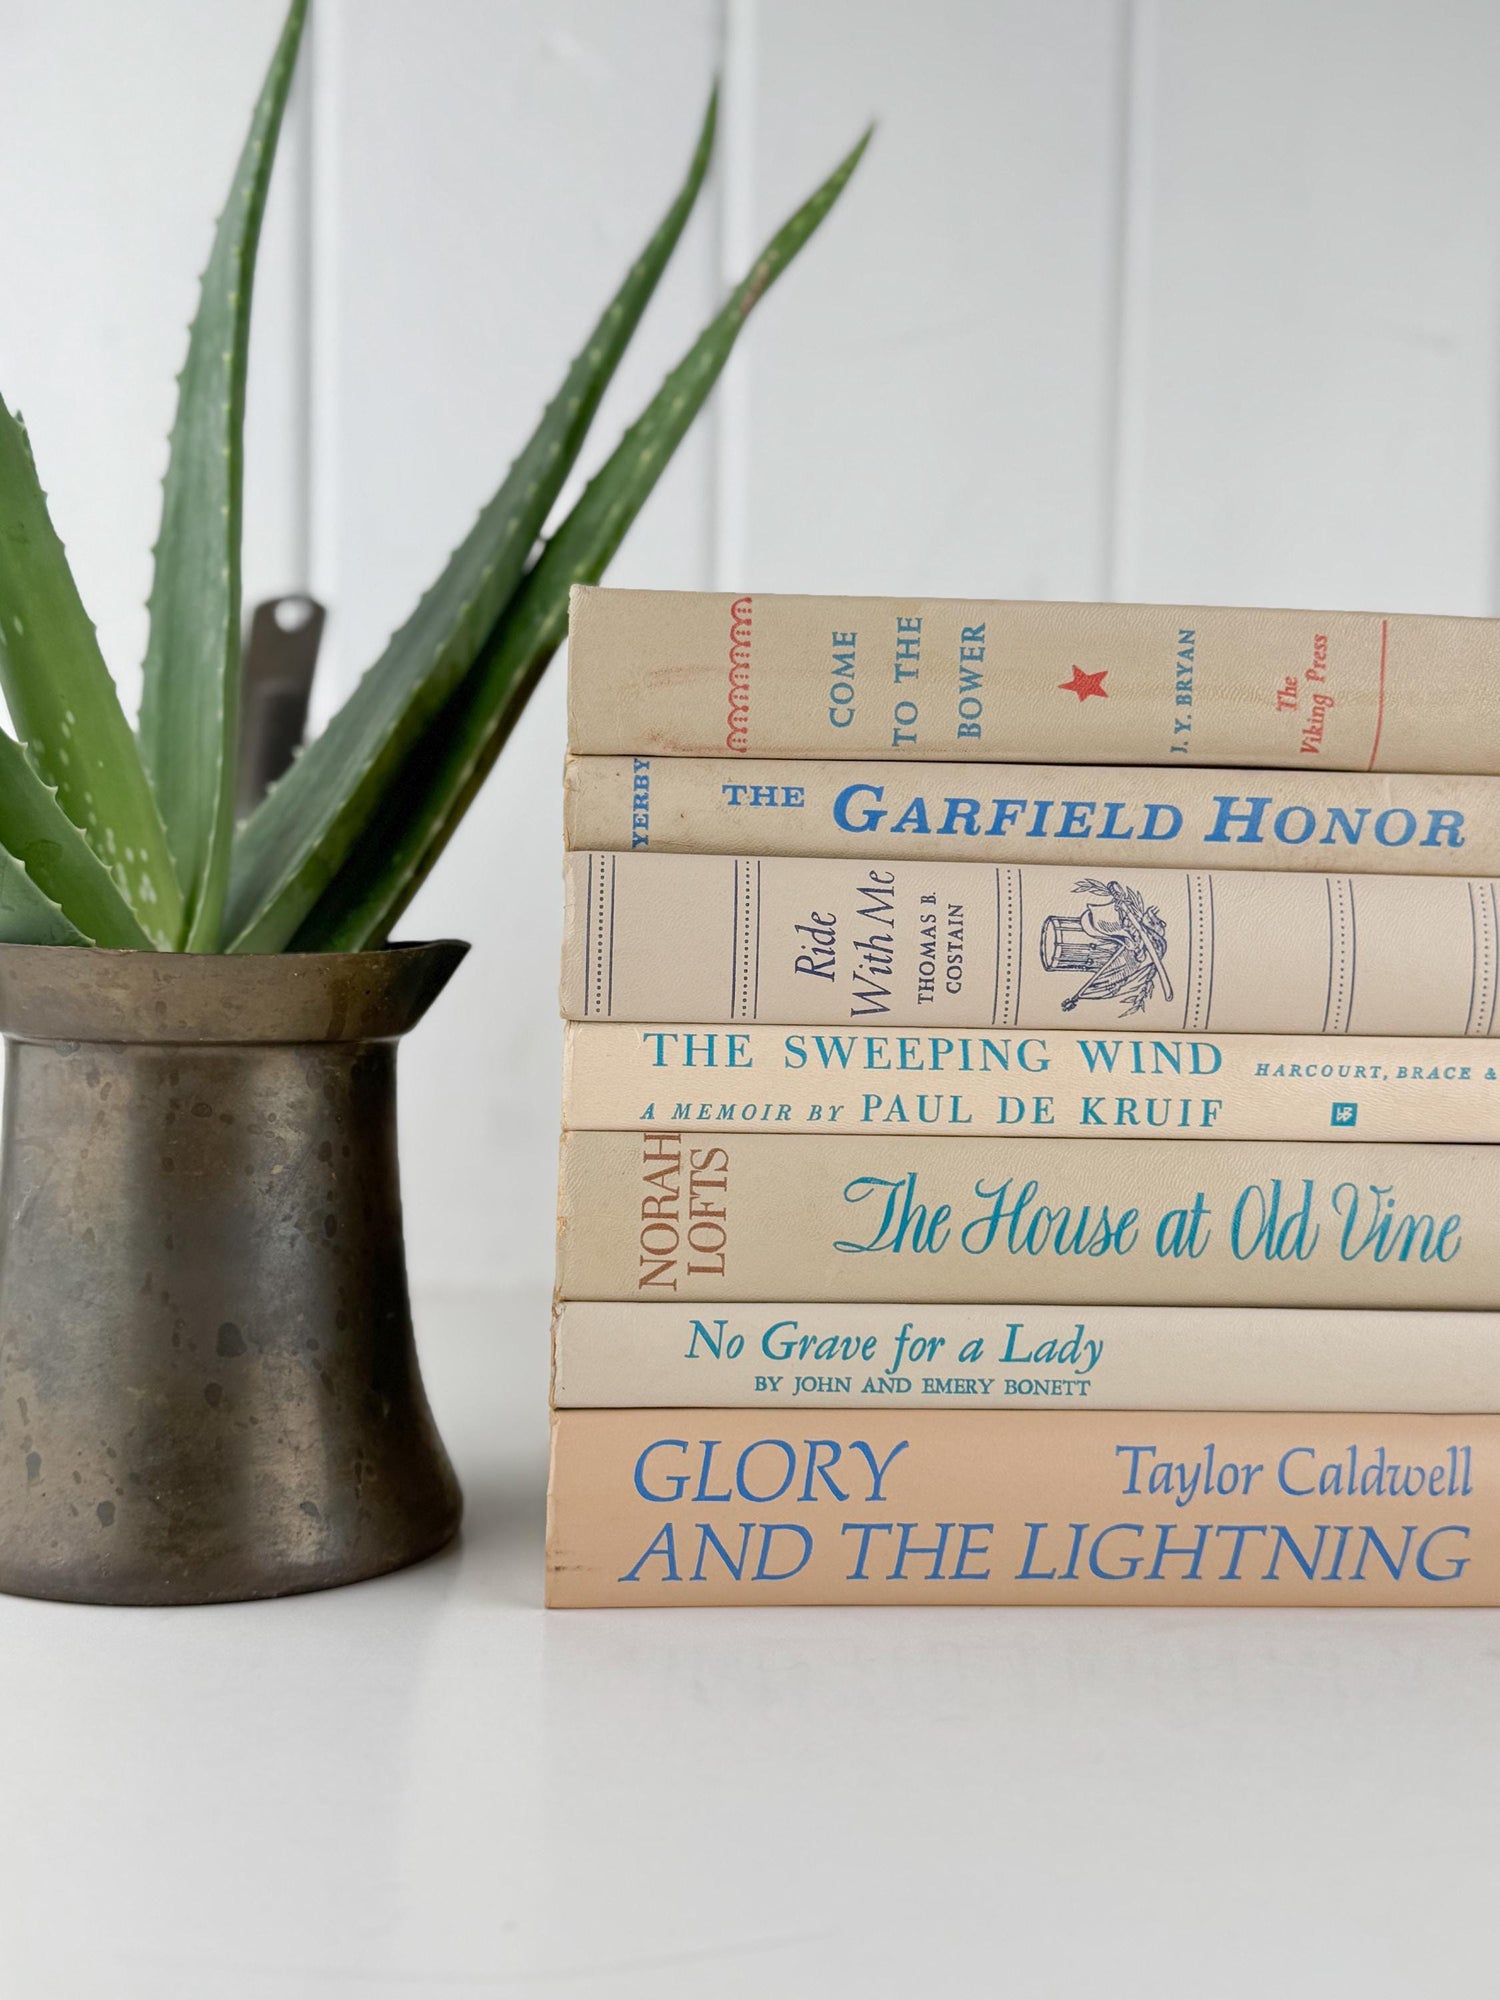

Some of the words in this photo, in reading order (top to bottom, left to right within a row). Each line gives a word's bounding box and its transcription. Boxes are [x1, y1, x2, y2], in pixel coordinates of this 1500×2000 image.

[829, 630, 858, 728] COME
[894, 616, 924, 684] THE
[957, 623, 986, 740] BOWER
[1175, 629, 1196, 707] BRYAN
[1306, 634, 1329, 684] Press
[892, 698, 919, 747] TO
[1174, 708, 1192, 734] Y.
[1275, 676, 1299, 712] The
[1300, 694, 1335, 755] Viking
[1170, 740, 1189, 754] J.
[632, 758, 651, 849] YERBY
[722, 784, 805, 808] THE
[833, 784, 1184, 841] GARFIELD
[1203, 796, 1467, 849] HONOR
[857, 870, 896, 930] Me
[921, 892, 937, 908] B.
[794, 911, 838, 982] Ride
[850, 933, 894, 1018] With
[918, 914, 938, 1005] THOMAS
[946, 903, 965, 994] COSTAIN
[643, 1033, 753, 1068] THE
[785, 1036, 1051, 1073] SWEEPING
[1076, 1040, 1223, 1075] WIND
[1254, 1063, 1388, 1081] HARCOURT,
[1396, 1065, 1472, 1080] BRACE
[1484, 1067, 1497, 1080] &
[640, 1103, 656, 1120] A
[672, 1103, 792, 1121] MEMOIR
[806, 1104, 844, 1122] BY
[860, 1094, 974, 1123] PAUL
[996, 1096, 1055, 1124] DE
[1080, 1098, 1223, 1127] KRUIF
[639, 1132, 681, 1291] NORAH
[687, 1147, 729, 1276] LOFTS
[832, 1172, 952, 1254] The
[961, 1177, 1140, 1258] House
[1154, 1192, 1211, 1259] at
[1230, 1178, 1320, 1261] Old
[1332, 1182, 1462, 1263] Vine
[685, 1320, 745, 1360] No
[761, 1321, 876, 1361] Grave
[884, 1323, 946, 1375] for
[958, 1335, 985, 1363] a
[999, 1323, 1103, 1374] Lady
[755, 1376, 784, 1392] BY
[792, 1376, 852, 1395] JOHN
[861, 1377, 912, 1394] AND
[921, 1377, 995, 1395] EMERY
[1004, 1378, 1091, 1396] BONETT
[633, 1439, 910, 1502] GLORY
[1115, 1443, 1264, 1507] Taylor
[1277, 1444, 1474, 1497] Caldwell
[617, 1522, 813, 1582] AND
[841, 1522, 994, 1580] THE
[1013, 1522, 1471, 1581] LIGHTNING
